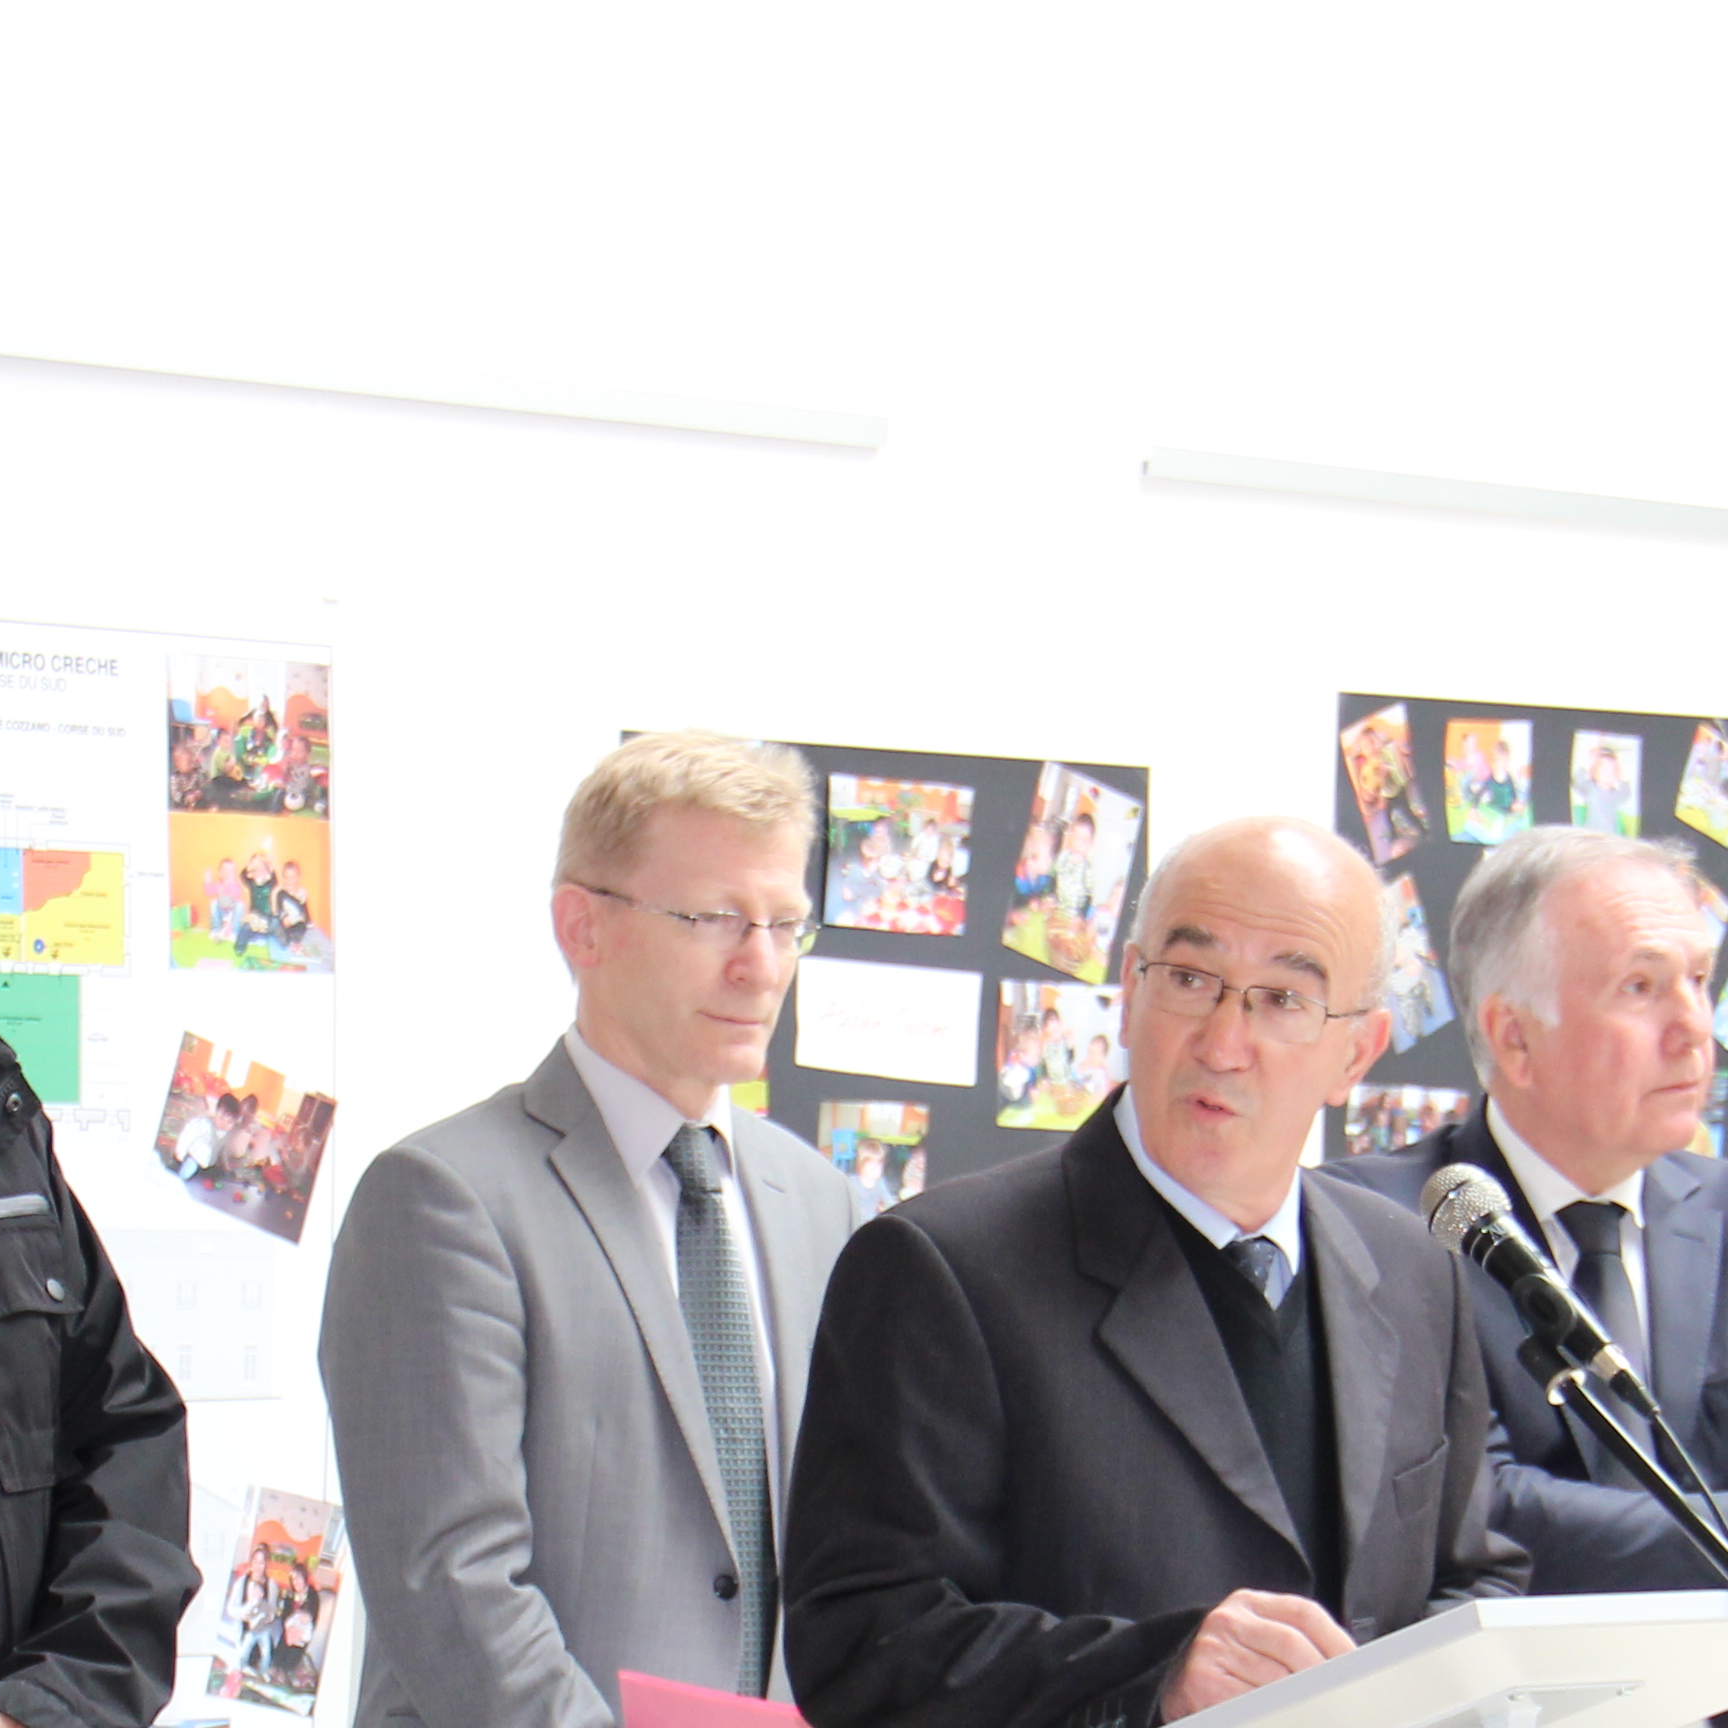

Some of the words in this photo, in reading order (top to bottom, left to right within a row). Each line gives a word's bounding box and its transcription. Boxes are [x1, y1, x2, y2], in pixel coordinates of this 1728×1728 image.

[50, 654, 120, 677] CRECHE
[19, 675, 37, 690] DU
[40, 676, 67, 692] SUD
[6, 719, 50, 733] COZZANO
[58, 723, 90, 736] CORSE
[92, 725, 105, 736] DU
[107, 726, 126, 738] SUD
